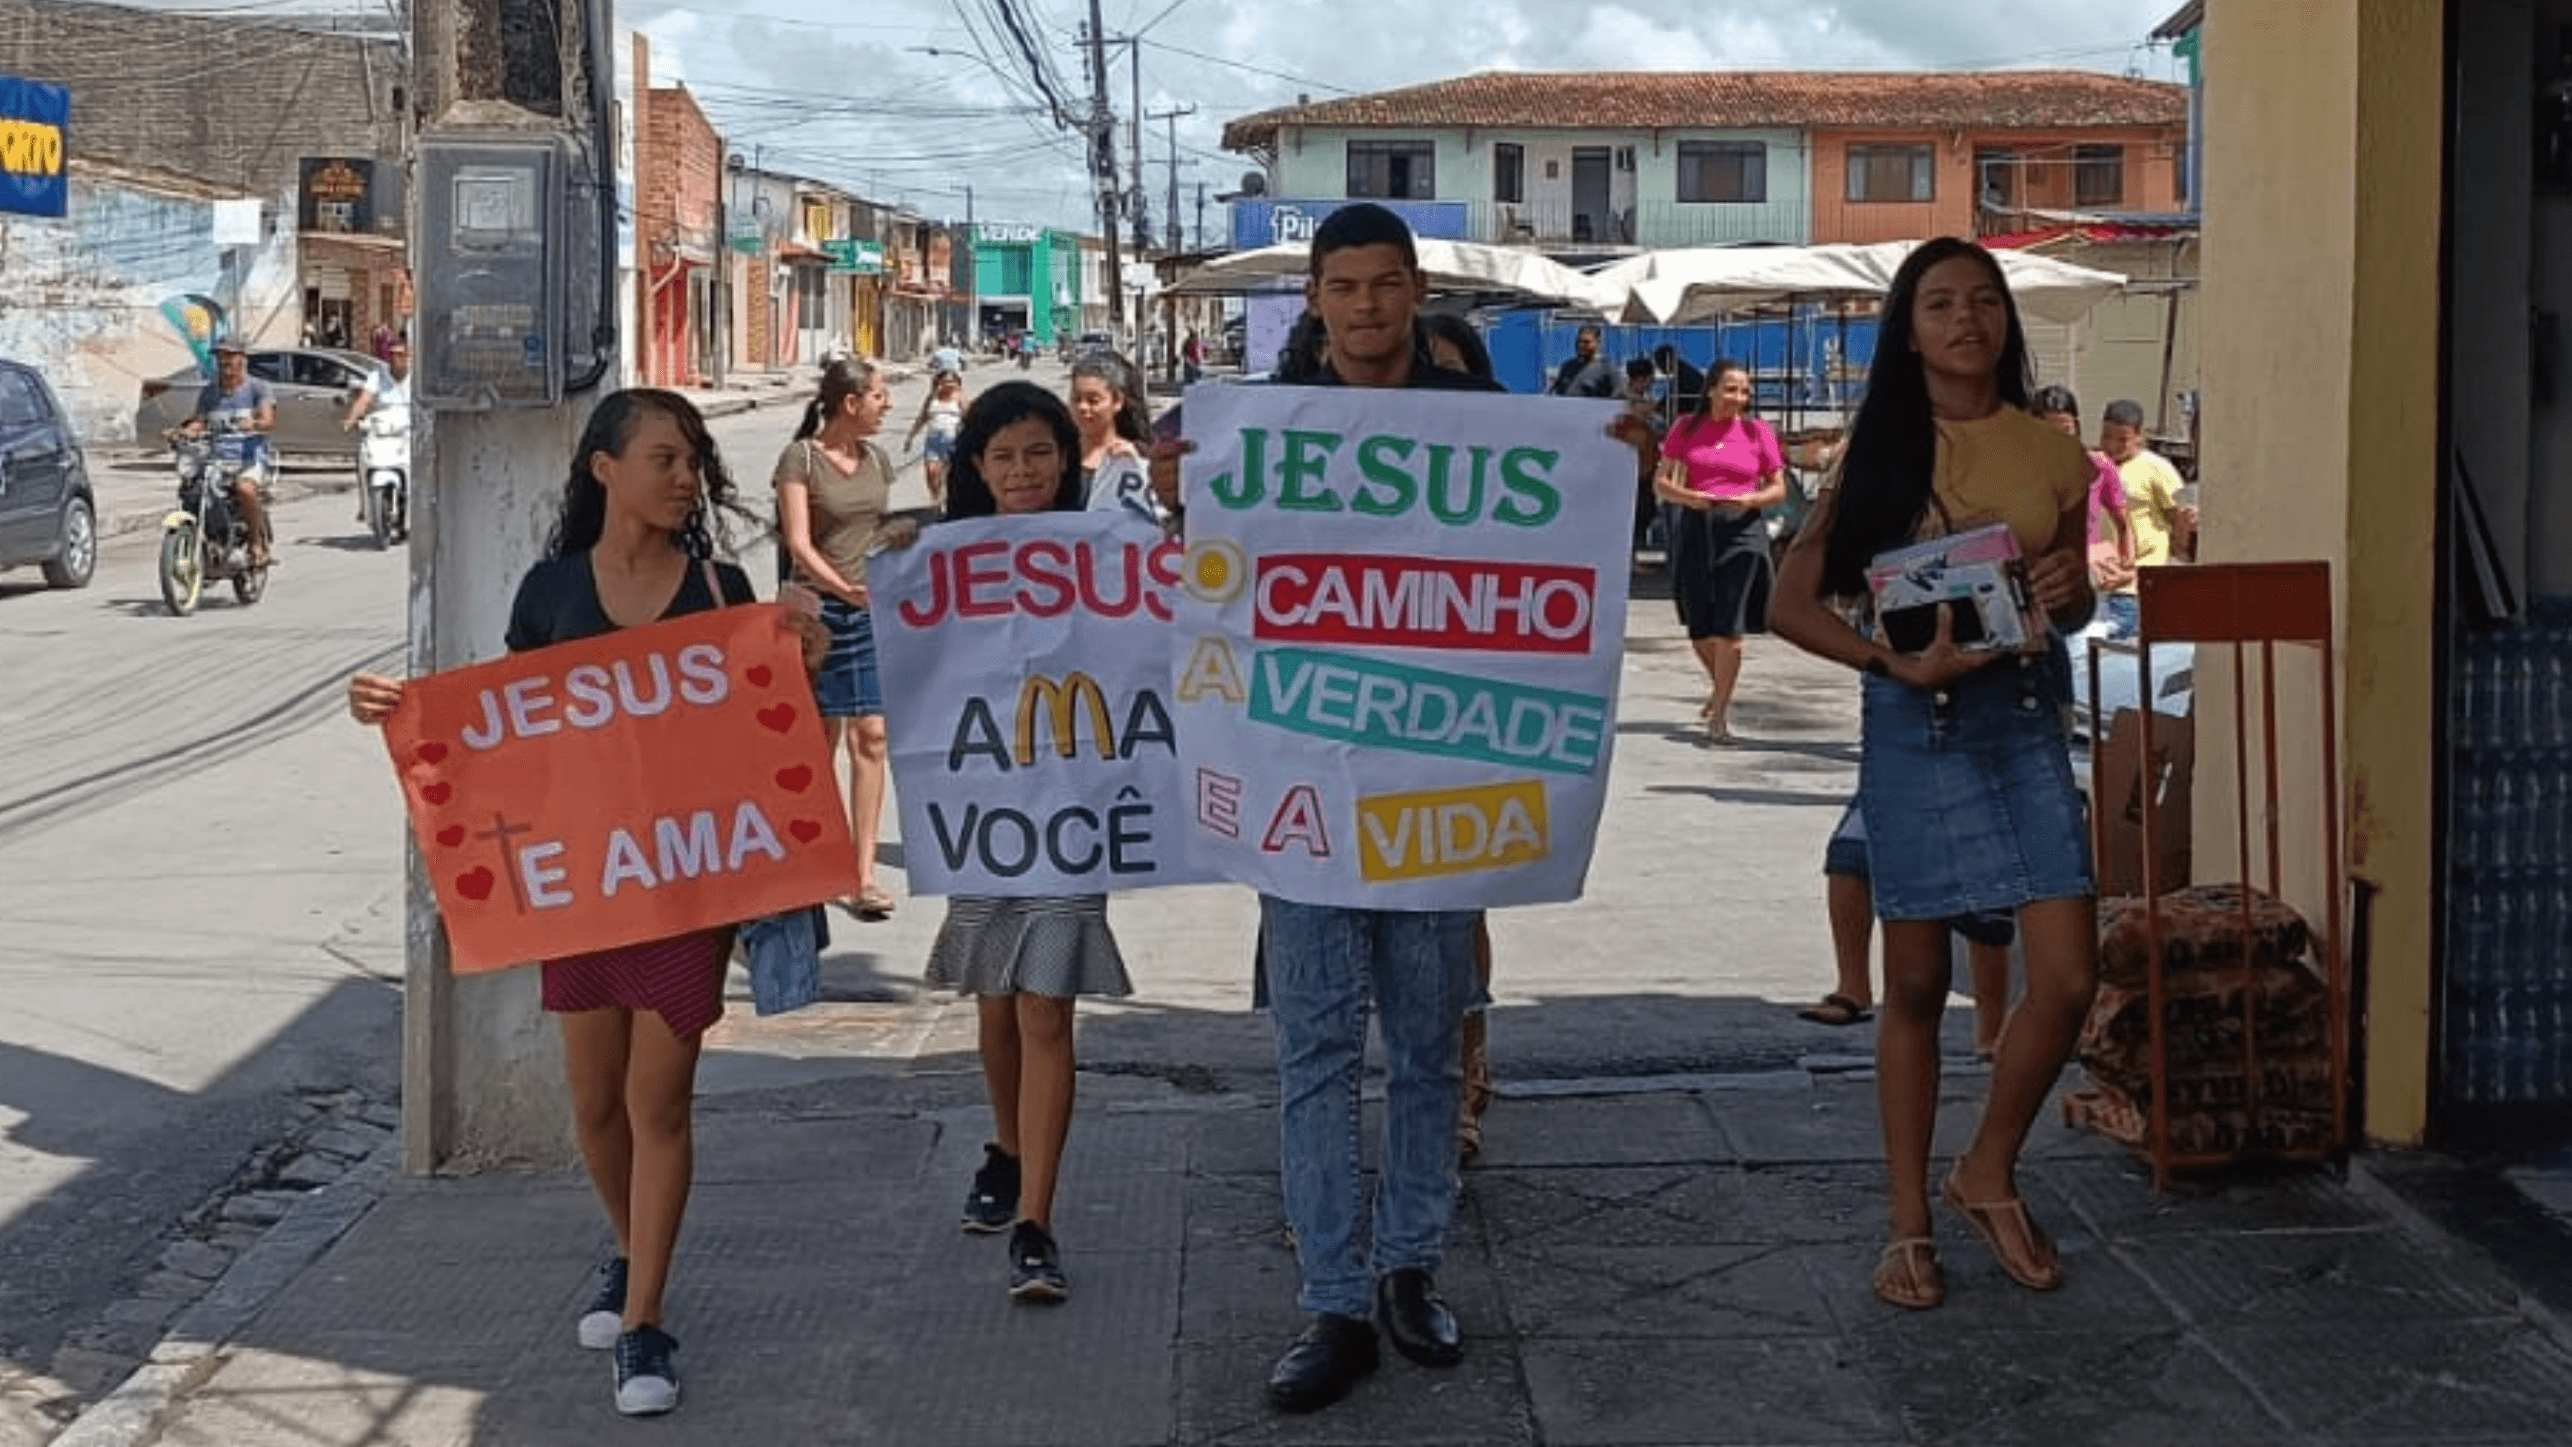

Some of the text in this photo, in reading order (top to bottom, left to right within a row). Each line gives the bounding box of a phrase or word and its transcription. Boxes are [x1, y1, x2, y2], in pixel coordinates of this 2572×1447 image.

[0, 119, 63, 175] ORTO
[1208, 427, 1562, 528] JESUS
[899, 539, 1186, 628] JESUS
[1180, 537, 1592, 640] O CAMINHO
[460, 643, 731, 751] JESUS
[948, 670, 1177, 773] AMA
[1176, 633, 1604, 767] A VERDADE
[602, 800, 787, 898] AMA
[926, 785, 1157, 878] VOCÊ
[1197, 766, 1544, 870] E A VIDA
